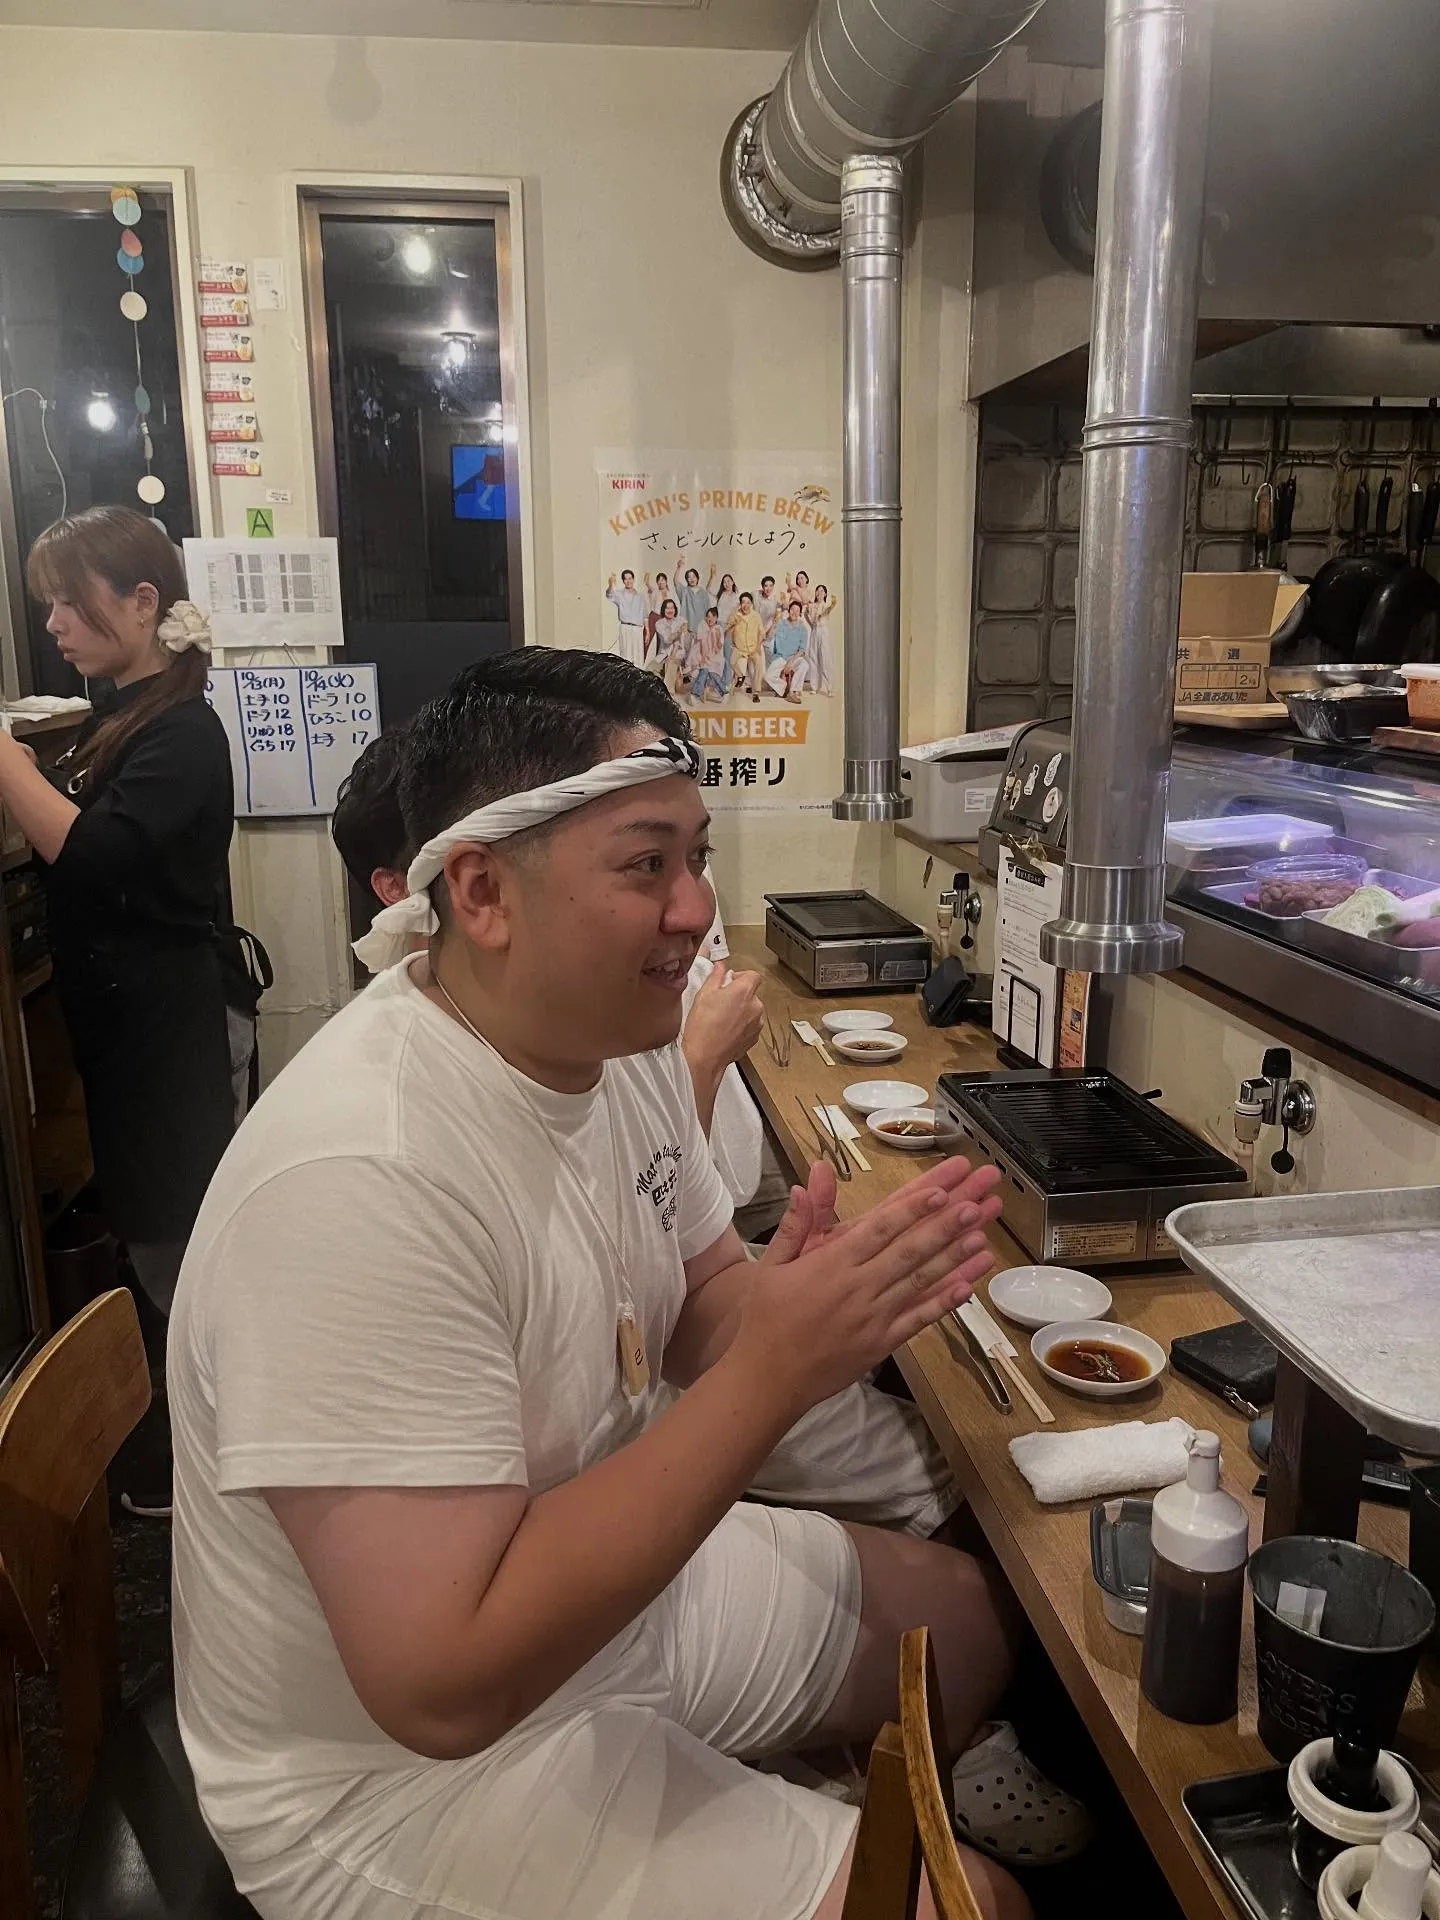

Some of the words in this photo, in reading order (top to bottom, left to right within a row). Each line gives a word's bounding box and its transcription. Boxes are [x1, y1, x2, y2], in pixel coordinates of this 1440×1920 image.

[612, 479, 645, 490] KIRIN
[608, 493, 691, 536] KIRIN'S
[699, 490, 767, 512] PRIME
[773, 497, 835, 536] BREW
[273, 694, 290, 705] 10
[346, 693, 366, 705] 10
[275, 708, 291, 720] 12
[352, 708, 372, 722] 10
[278, 723, 295, 736] 18
[732, 716, 798, 739] BEER
[352, 731, 369, 745] 17
[280, 739, 296, 752] 17
[699, 757, 786, 787] 番搾り
